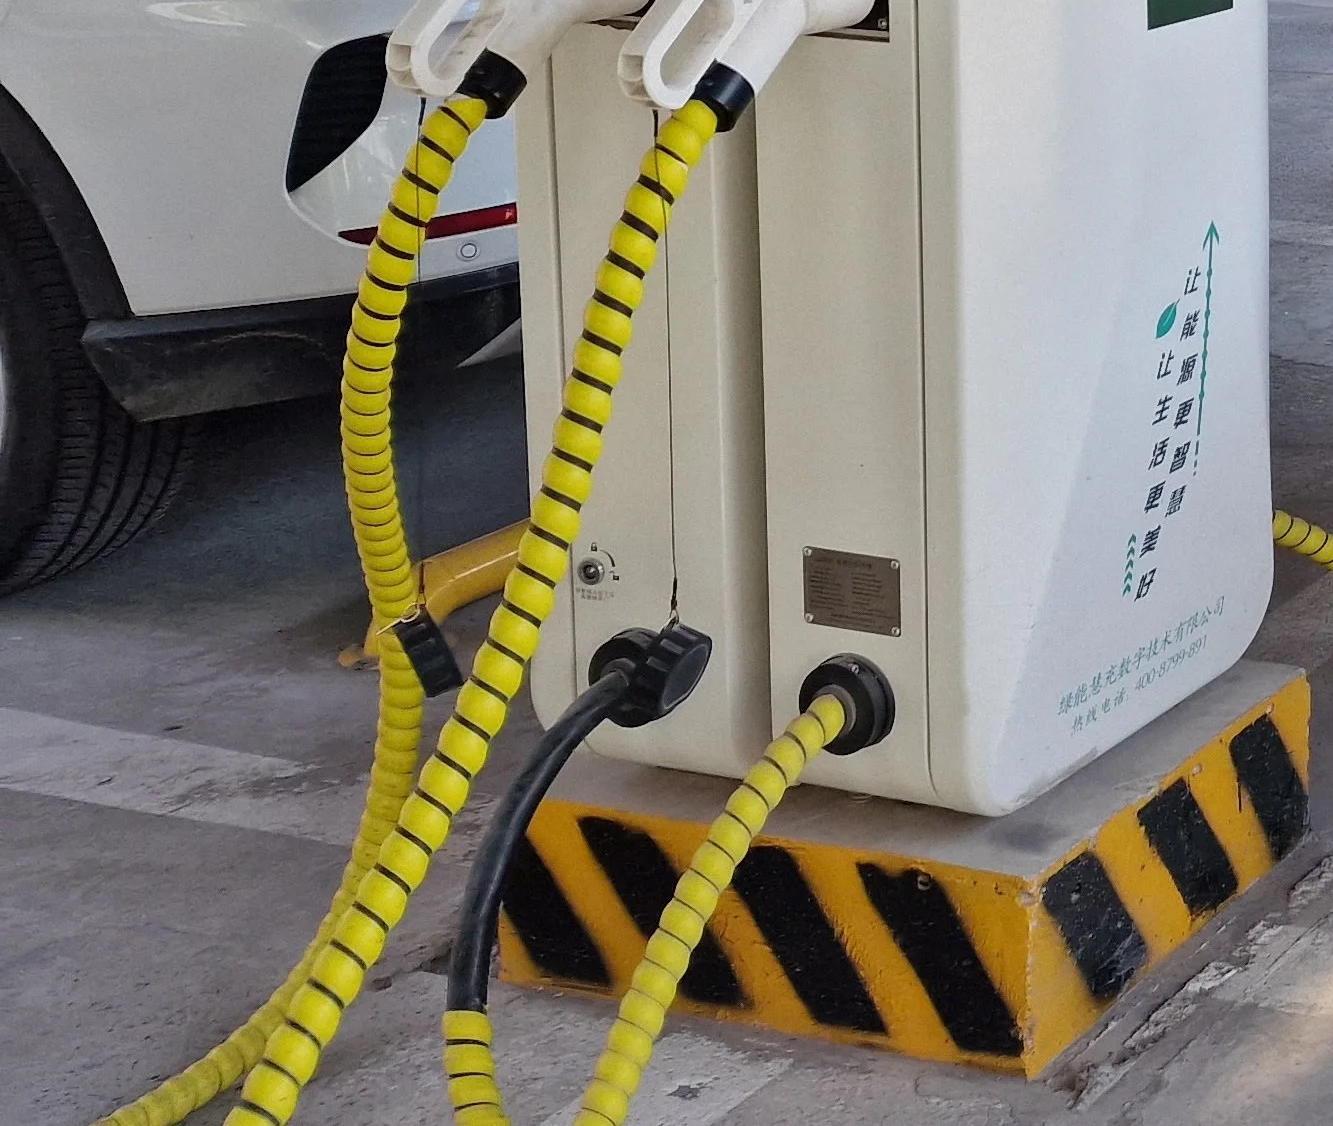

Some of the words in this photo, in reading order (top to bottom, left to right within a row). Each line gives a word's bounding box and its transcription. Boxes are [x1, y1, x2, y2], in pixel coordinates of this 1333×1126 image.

[1133, 350, 1176, 604] 让生活更美好
[1165, 267, 1202, 521] 让能源更智慧
